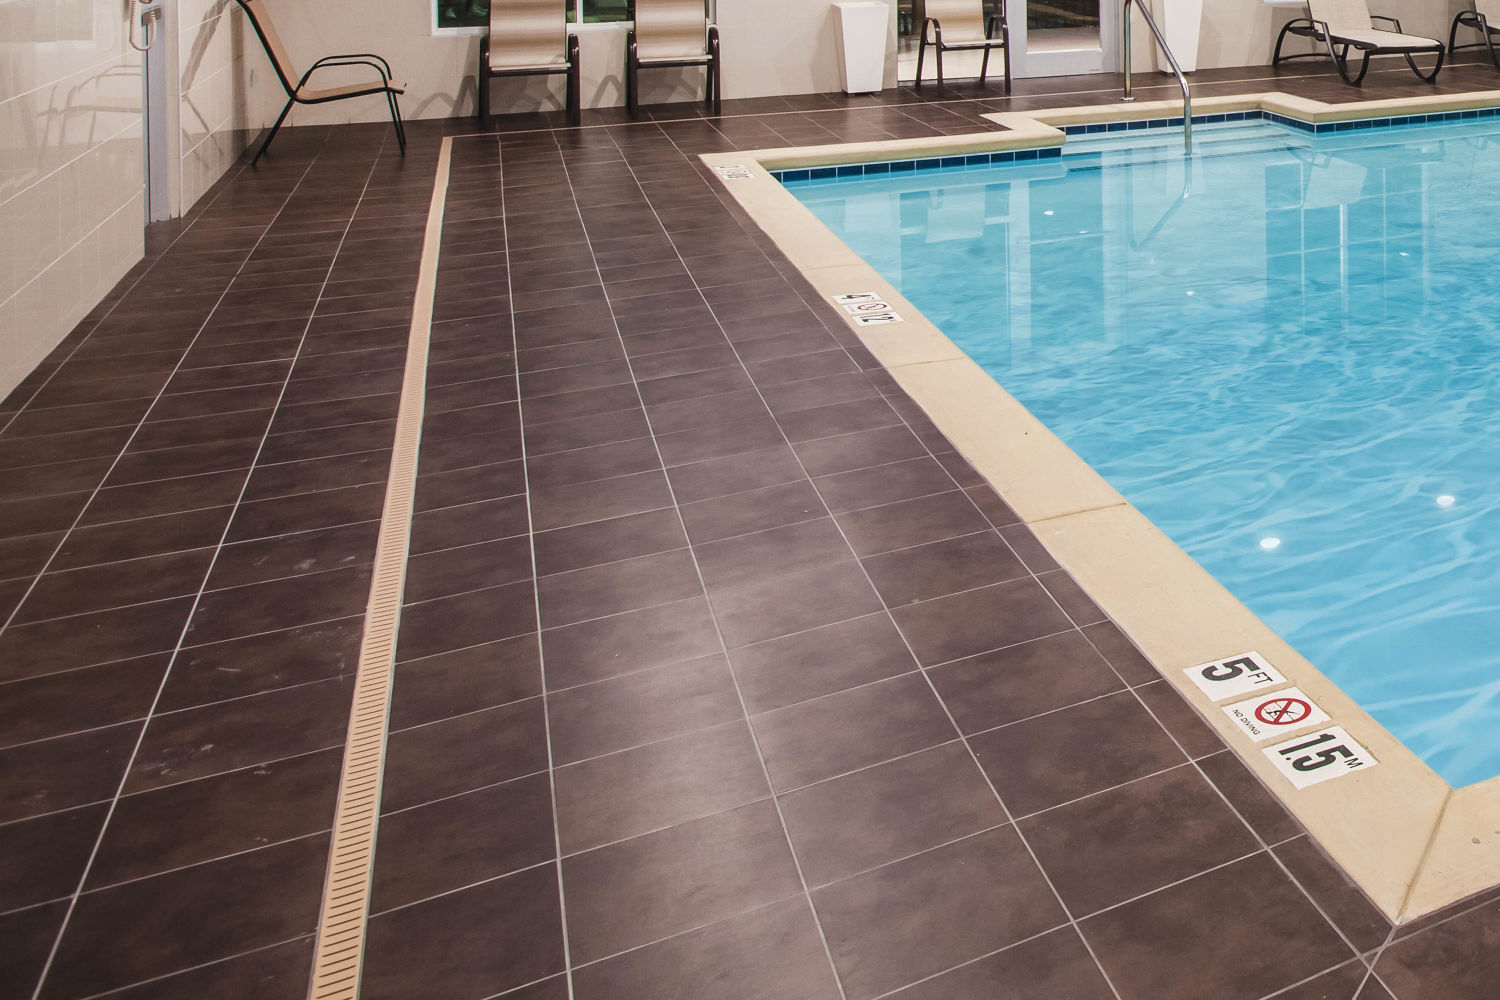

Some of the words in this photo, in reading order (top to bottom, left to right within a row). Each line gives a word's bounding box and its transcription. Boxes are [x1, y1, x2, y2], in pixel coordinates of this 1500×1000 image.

[1201, 657, 1260, 681] 5
[1248, 670, 1274, 684] FT
[1232, 707, 1244, 718] NO
[1241, 717, 1261, 736] DIVING
